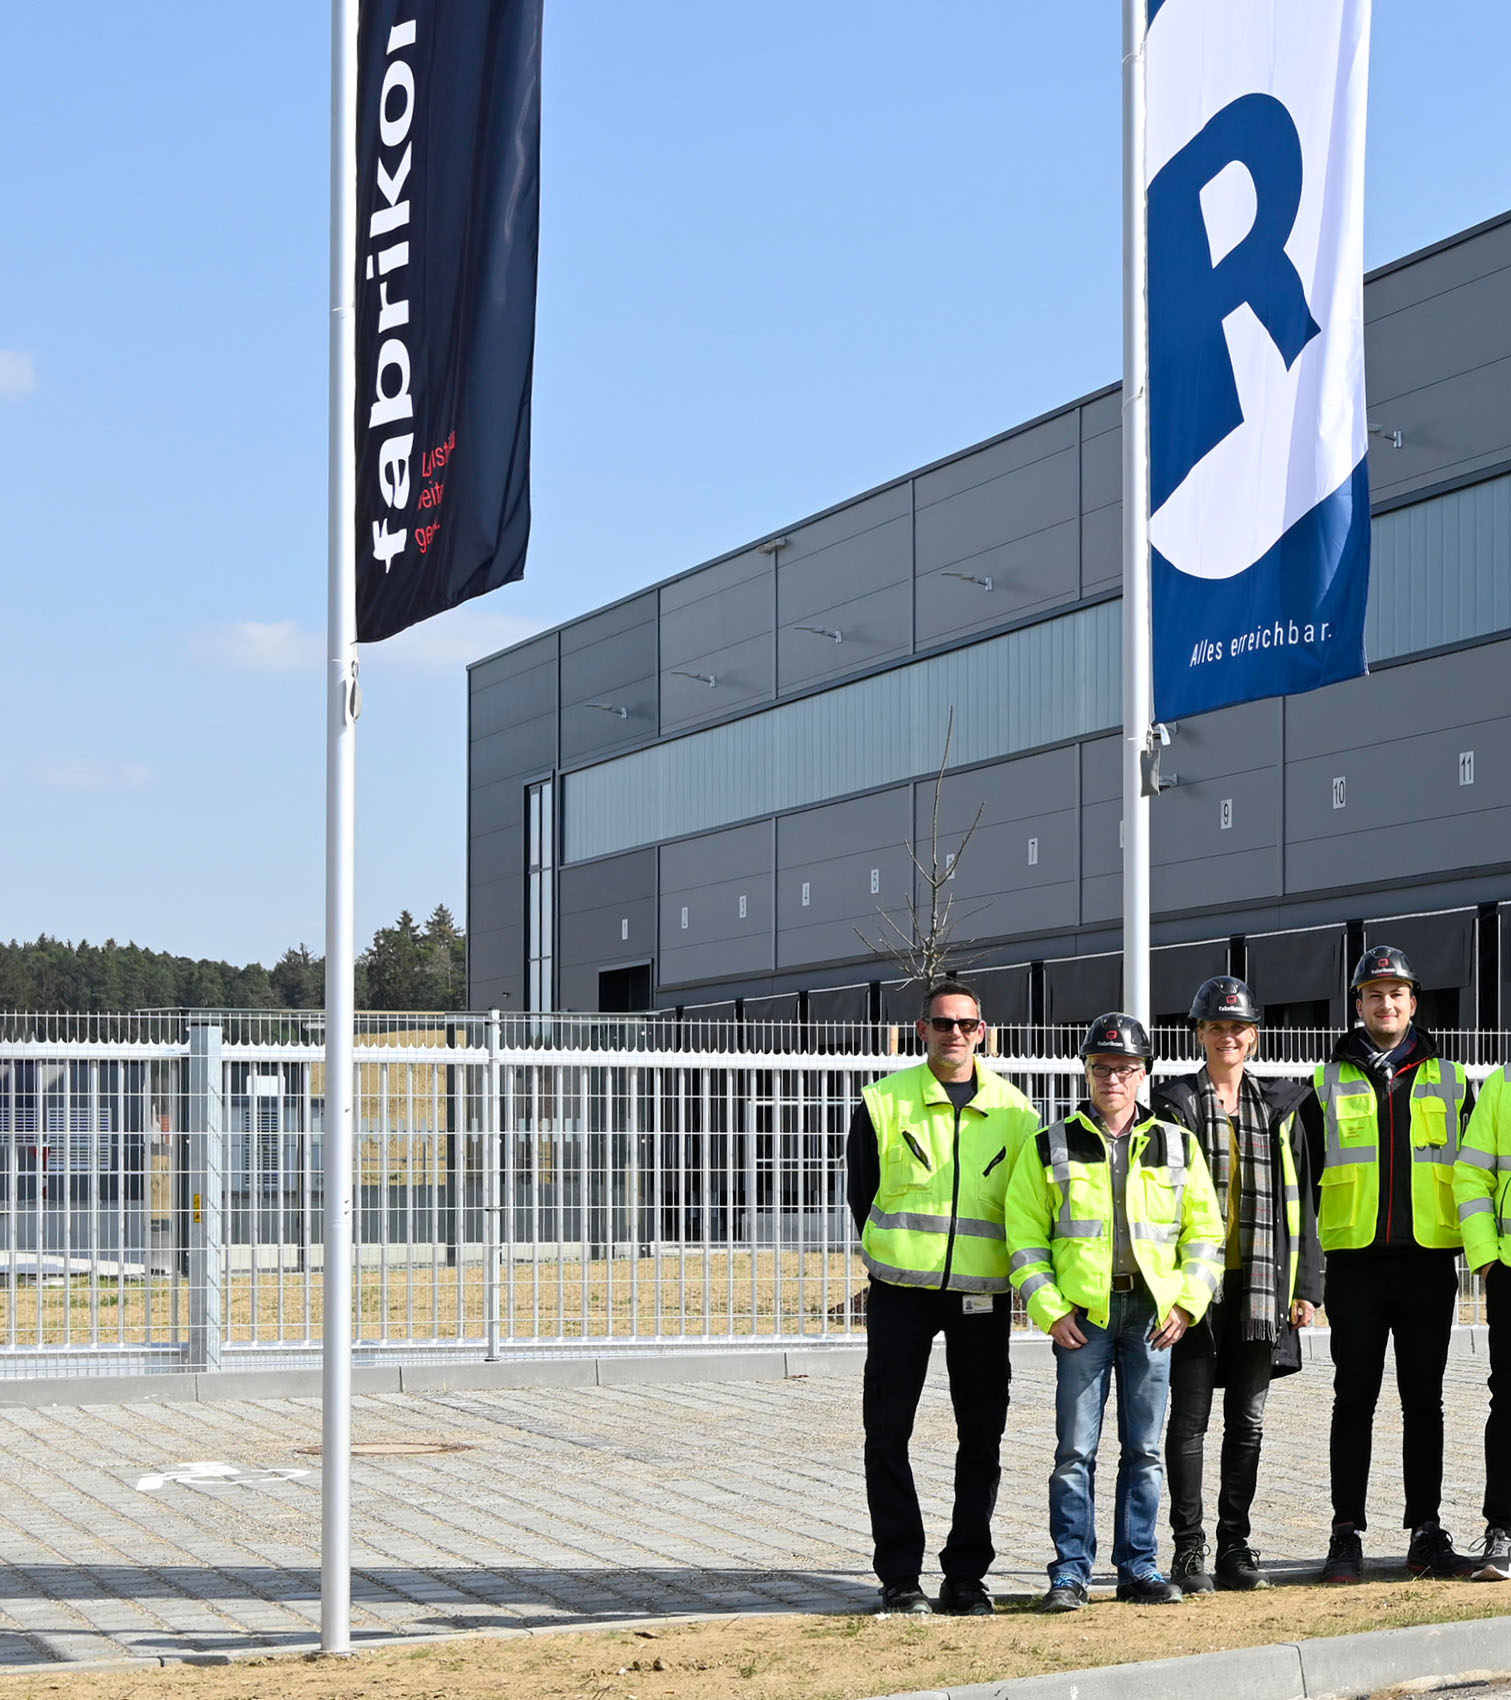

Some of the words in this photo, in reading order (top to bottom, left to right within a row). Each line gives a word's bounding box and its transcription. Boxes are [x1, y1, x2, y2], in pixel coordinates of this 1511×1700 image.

[1189, 639, 1223, 668] Alles
[1231, 619, 1332, 657] erreichbar.
[1461, 756, 1472, 783] 11
[1334, 781, 1345, 805] 10
[1223, 802, 1229, 825] 9
